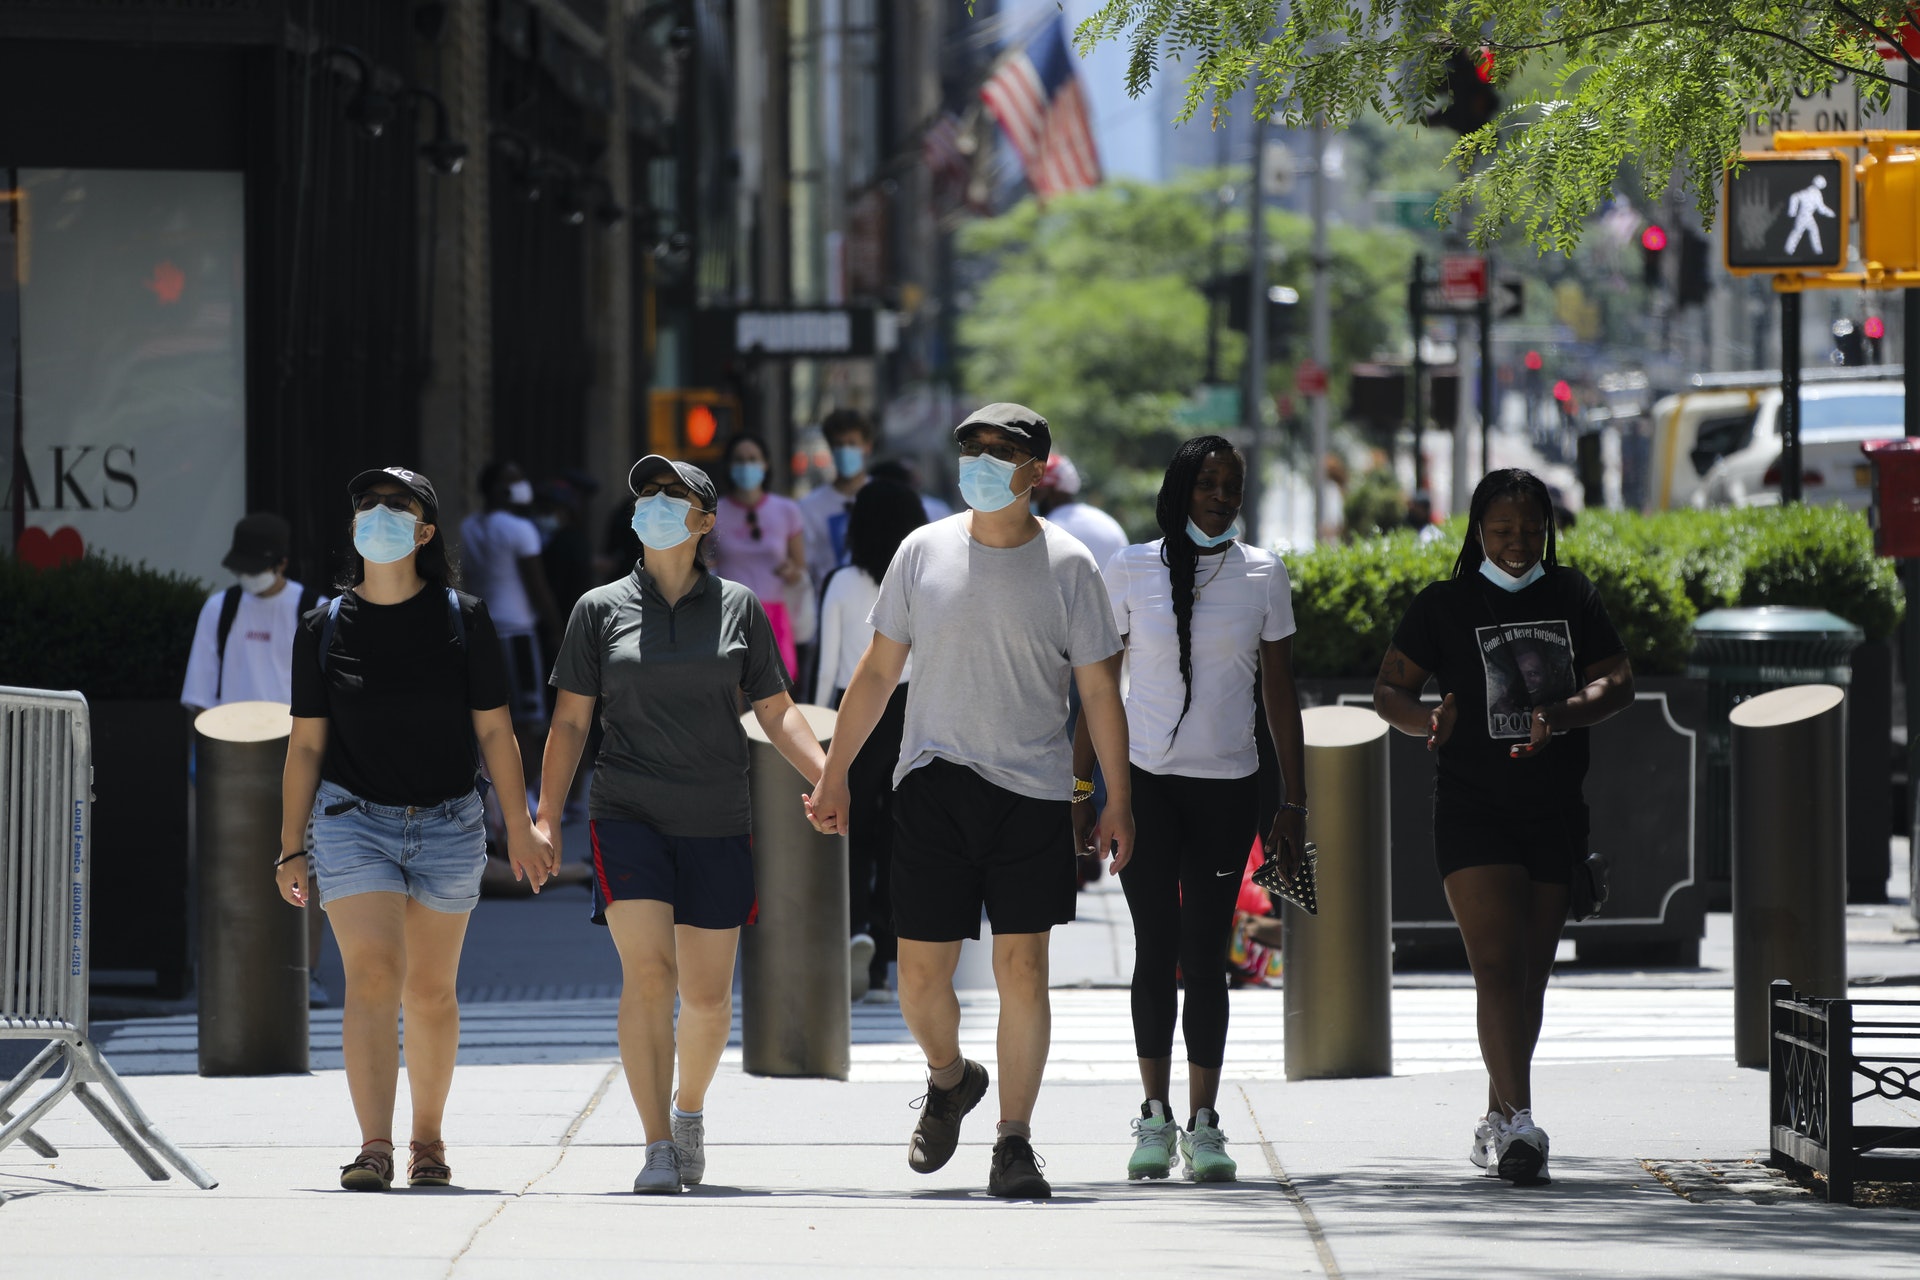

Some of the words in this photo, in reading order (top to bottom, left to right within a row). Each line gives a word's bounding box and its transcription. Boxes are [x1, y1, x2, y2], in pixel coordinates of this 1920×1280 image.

[1815, 109, 1848, 132] ON
[1483, 635, 1501, 653] Gone
[1513, 627, 1533, 640] Never
[1534, 627, 1567, 647] Forgotten
[1493, 712, 1532, 733] POO
[74, 800, 84, 832] Long
[73, 835, 84, 874] Fence
[71, 882, 82, 977] (800)486-4283
